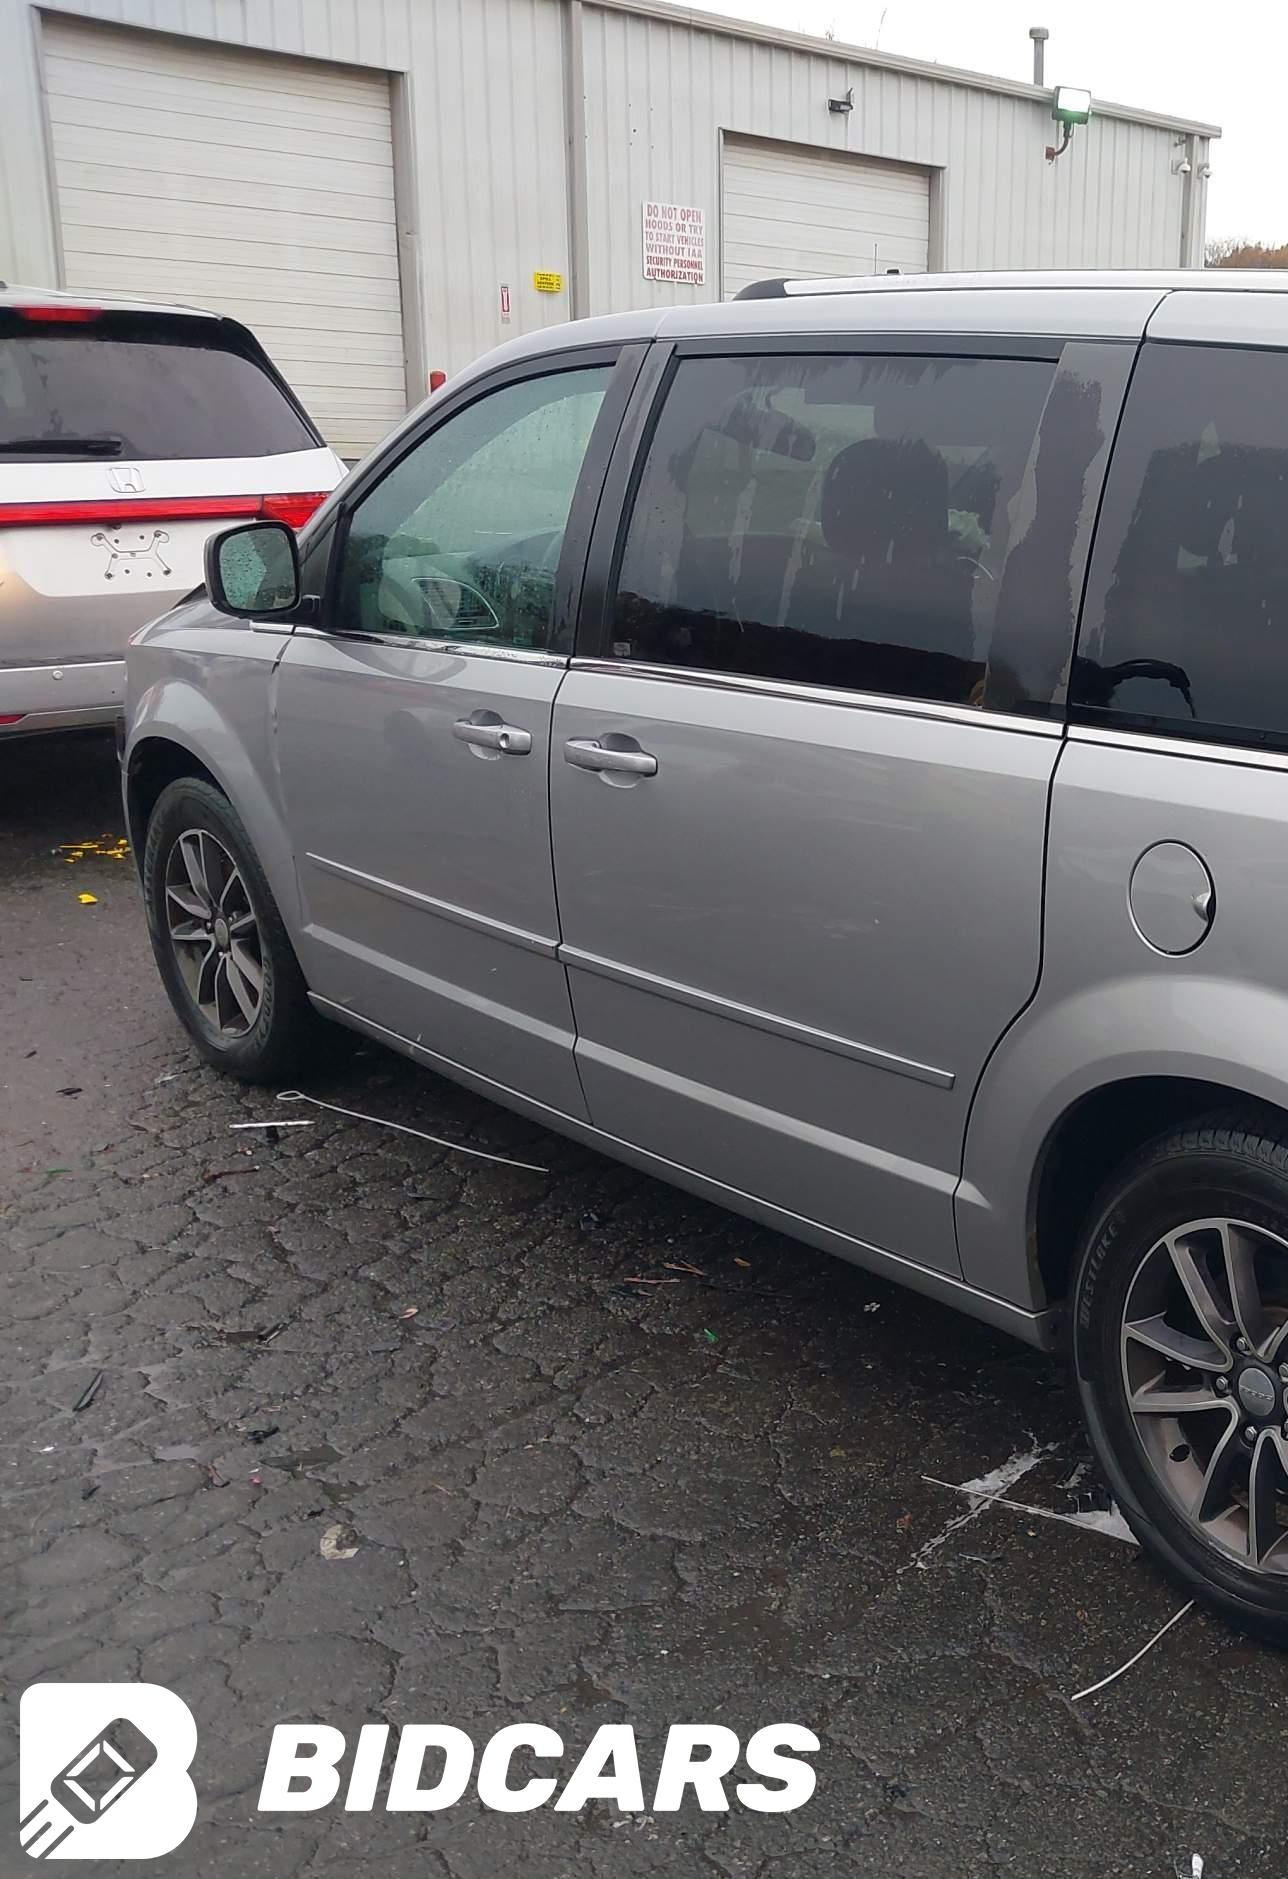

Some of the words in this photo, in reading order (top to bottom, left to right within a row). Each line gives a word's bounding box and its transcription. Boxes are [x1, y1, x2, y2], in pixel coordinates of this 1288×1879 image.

[647, 203, 659, 218] DO
[661, 205, 678, 221] NOT
[680, 208, 702, 224] OPEN
[645, 218, 673, 231] HOODS
[675, 223, 687, 233] OR
[689, 224, 703, 235] TRY
[645, 231, 654, 241] TO
[655, 232, 675, 244] START
[676, 235, 704, 247] VEHICLES
[645, 243, 686, 257] WITHOUT
[688, 247, 703, 258] IAA
[646, 255, 672, 267] SECURITY
[673, 258, 704, 271] PERSONNEL
[646, 267, 704, 283] AUTHORIZATION
